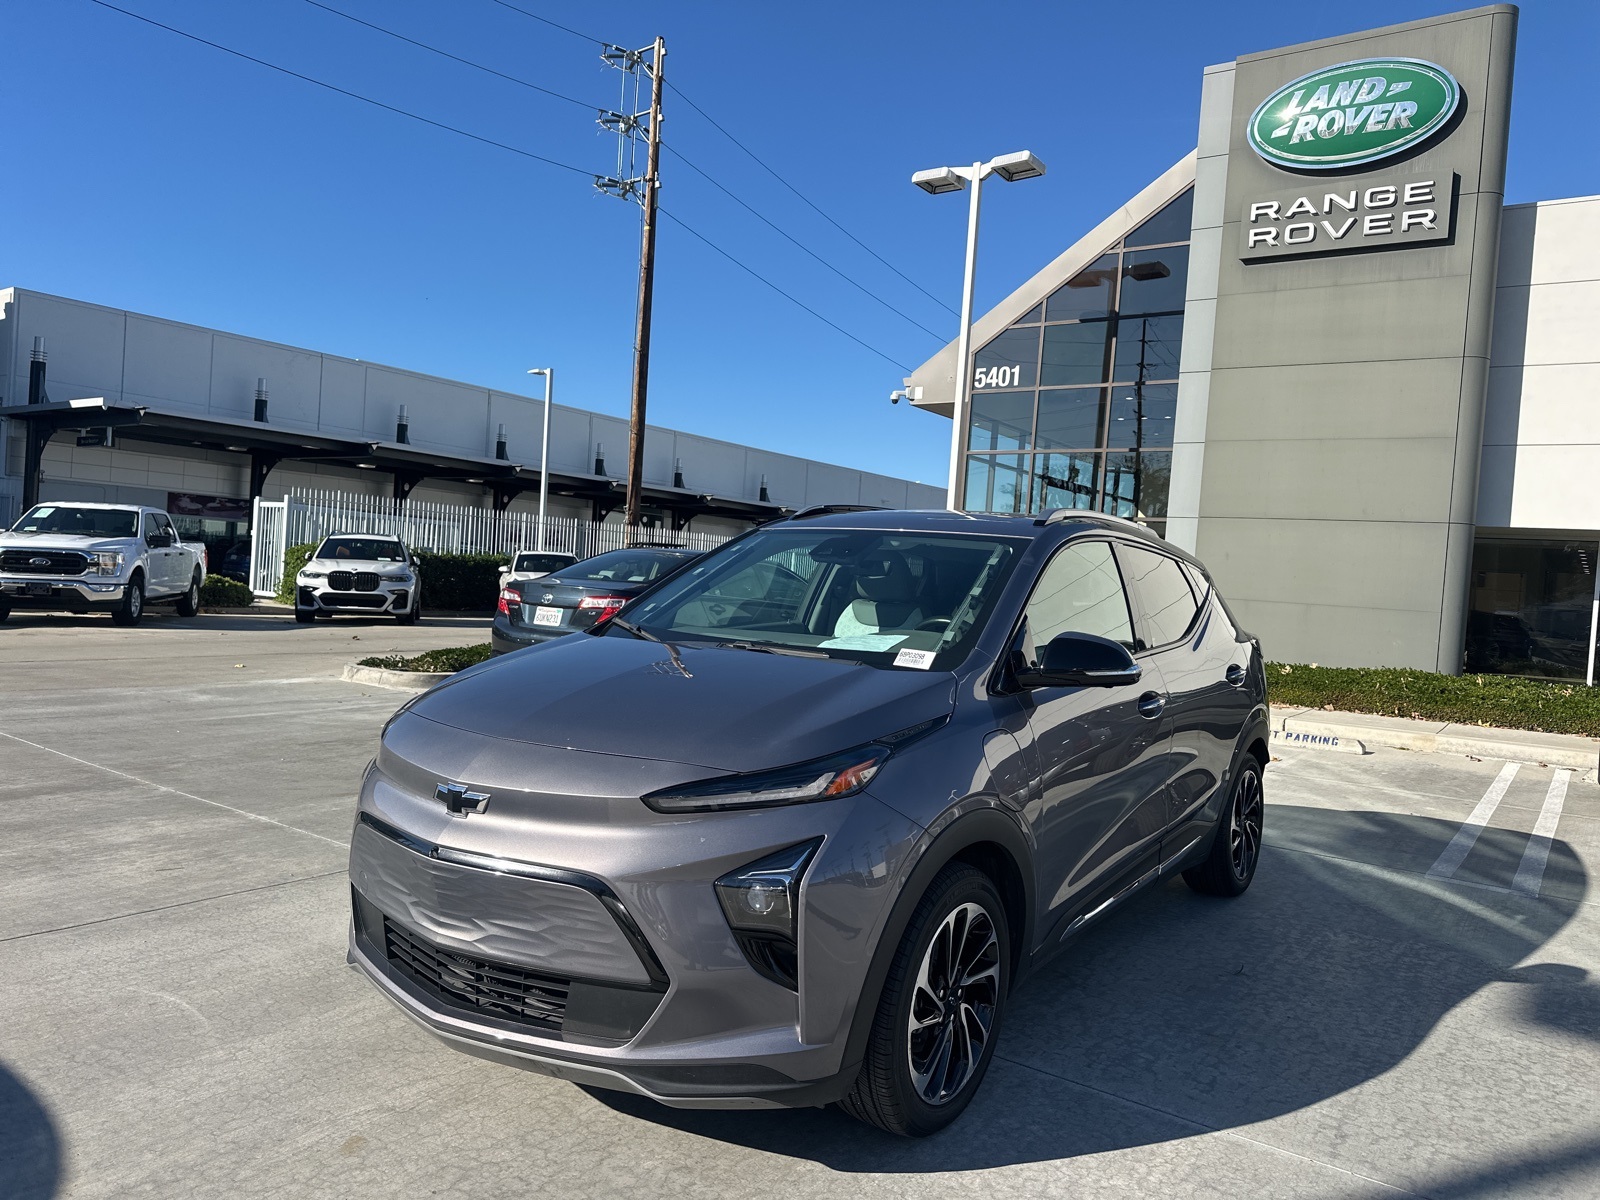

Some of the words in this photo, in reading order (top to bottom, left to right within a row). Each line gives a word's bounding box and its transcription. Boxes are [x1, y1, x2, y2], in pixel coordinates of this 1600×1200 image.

[1284, 76, 1388, 116] LAND
[1288, 100, 1419, 145] ROVER
[1249, 180, 1436, 223] RANGE
[1248, 208, 1437, 249] ROVER
[973, 364, 1020, 389] 5401
[1285, 732, 1340, 746] PARKING
